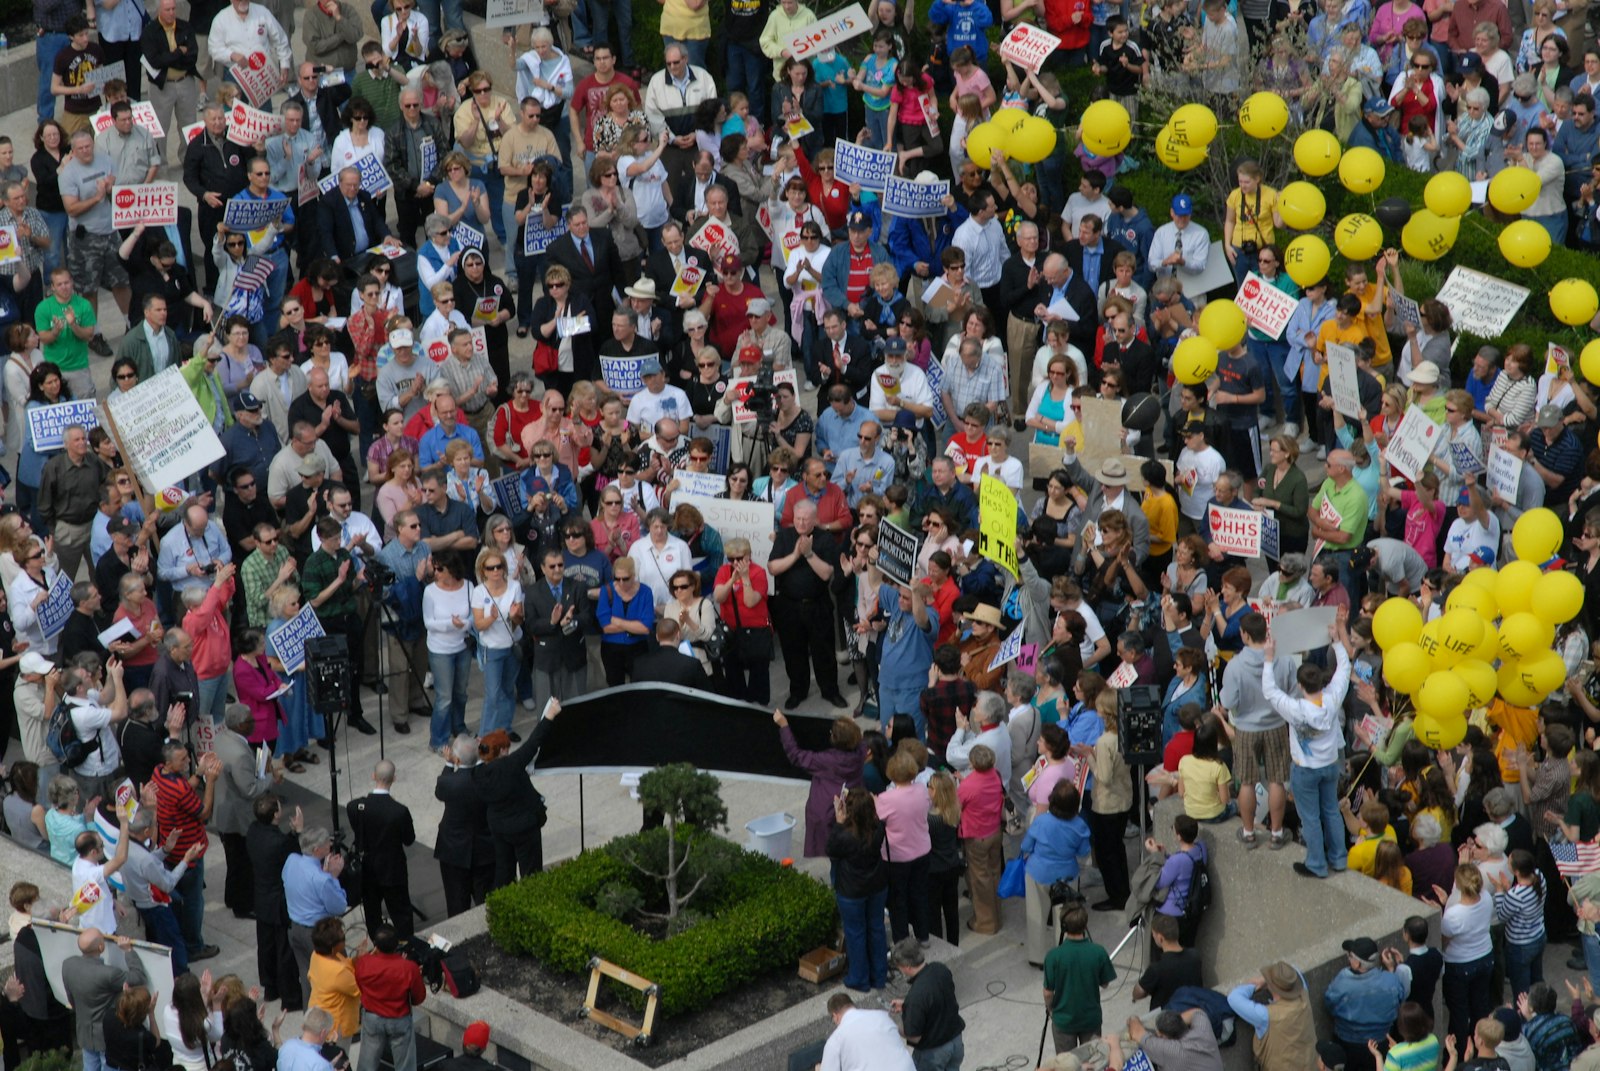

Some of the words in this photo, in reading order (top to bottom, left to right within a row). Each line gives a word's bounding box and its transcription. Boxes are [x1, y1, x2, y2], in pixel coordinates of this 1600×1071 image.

[1003, 42, 1042, 65] MANDATE
[1023, 37, 1050, 55] HHS
[257, 69, 275, 96] HHS
[233, 108, 246, 121] STOP
[1174, 120, 1190, 147] LIFE
[358, 154, 375, 168] UP
[837, 142, 874, 162] STAND
[876, 153, 893, 165] UP
[842, 154, 890, 173] RELIGIOUS
[137, 186, 175, 194] OBAMA'S
[887, 178, 927, 193] STAND
[930, 184, 947, 194] UP
[115, 194, 135, 204] STOP
[137, 193, 174, 207] HHS
[229, 201, 269, 212] STAND
[115, 208, 174, 219] MANDATE
[467, 229, 481, 242] UP
[706, 226, 721, 243] STOP
[682, 271, 700, 283] STOP
[1244, 282, 1260, 296] STOP
[479, 301, 497, 310] STOP
[1263, 286, 1296, 309] OBAMA'S
[1235, 298, 1282, 330] MANDATE
[1257, 294, 1290, 320] HHS
[429, 348, 447, 357] STOP
[602, 360, 638, 372] STAND
[879, 376, 896, 385] STOP
[32, 402, 73, 422] STAND
[77, 401, 93, 413] UP
[42, 413, 95, 429] RELIGIOUS
[1502, 457, 1513, 467] will
[1495, 464, 1515, 482] sacrifice
[163, 487, 182, 503] STOP
[708, 506, 760, 524] STAND
[1223, 511, 1259, 522] OBAMA'S
[1223, 521, 1258, 536] HHS
[1266, 519, 1276, 529] UP
[882, 522, 894, 539] PRAY
[894, 532, 902, 545] TO
[901, 537, 914, 552] END
[880, 538, 912, 567] ABORTION
[37, 586, 62, 613] STAND
[58, 575, 68, 593] UP
[273, 613, 303, 645] STAND
[301, 606, 313, 623] UP
[283, 617, 317, 648] RELIGIOUS
[1444, 634, 1476, 657] LIFE
[1130, 1049, 1143, 1066] UP
